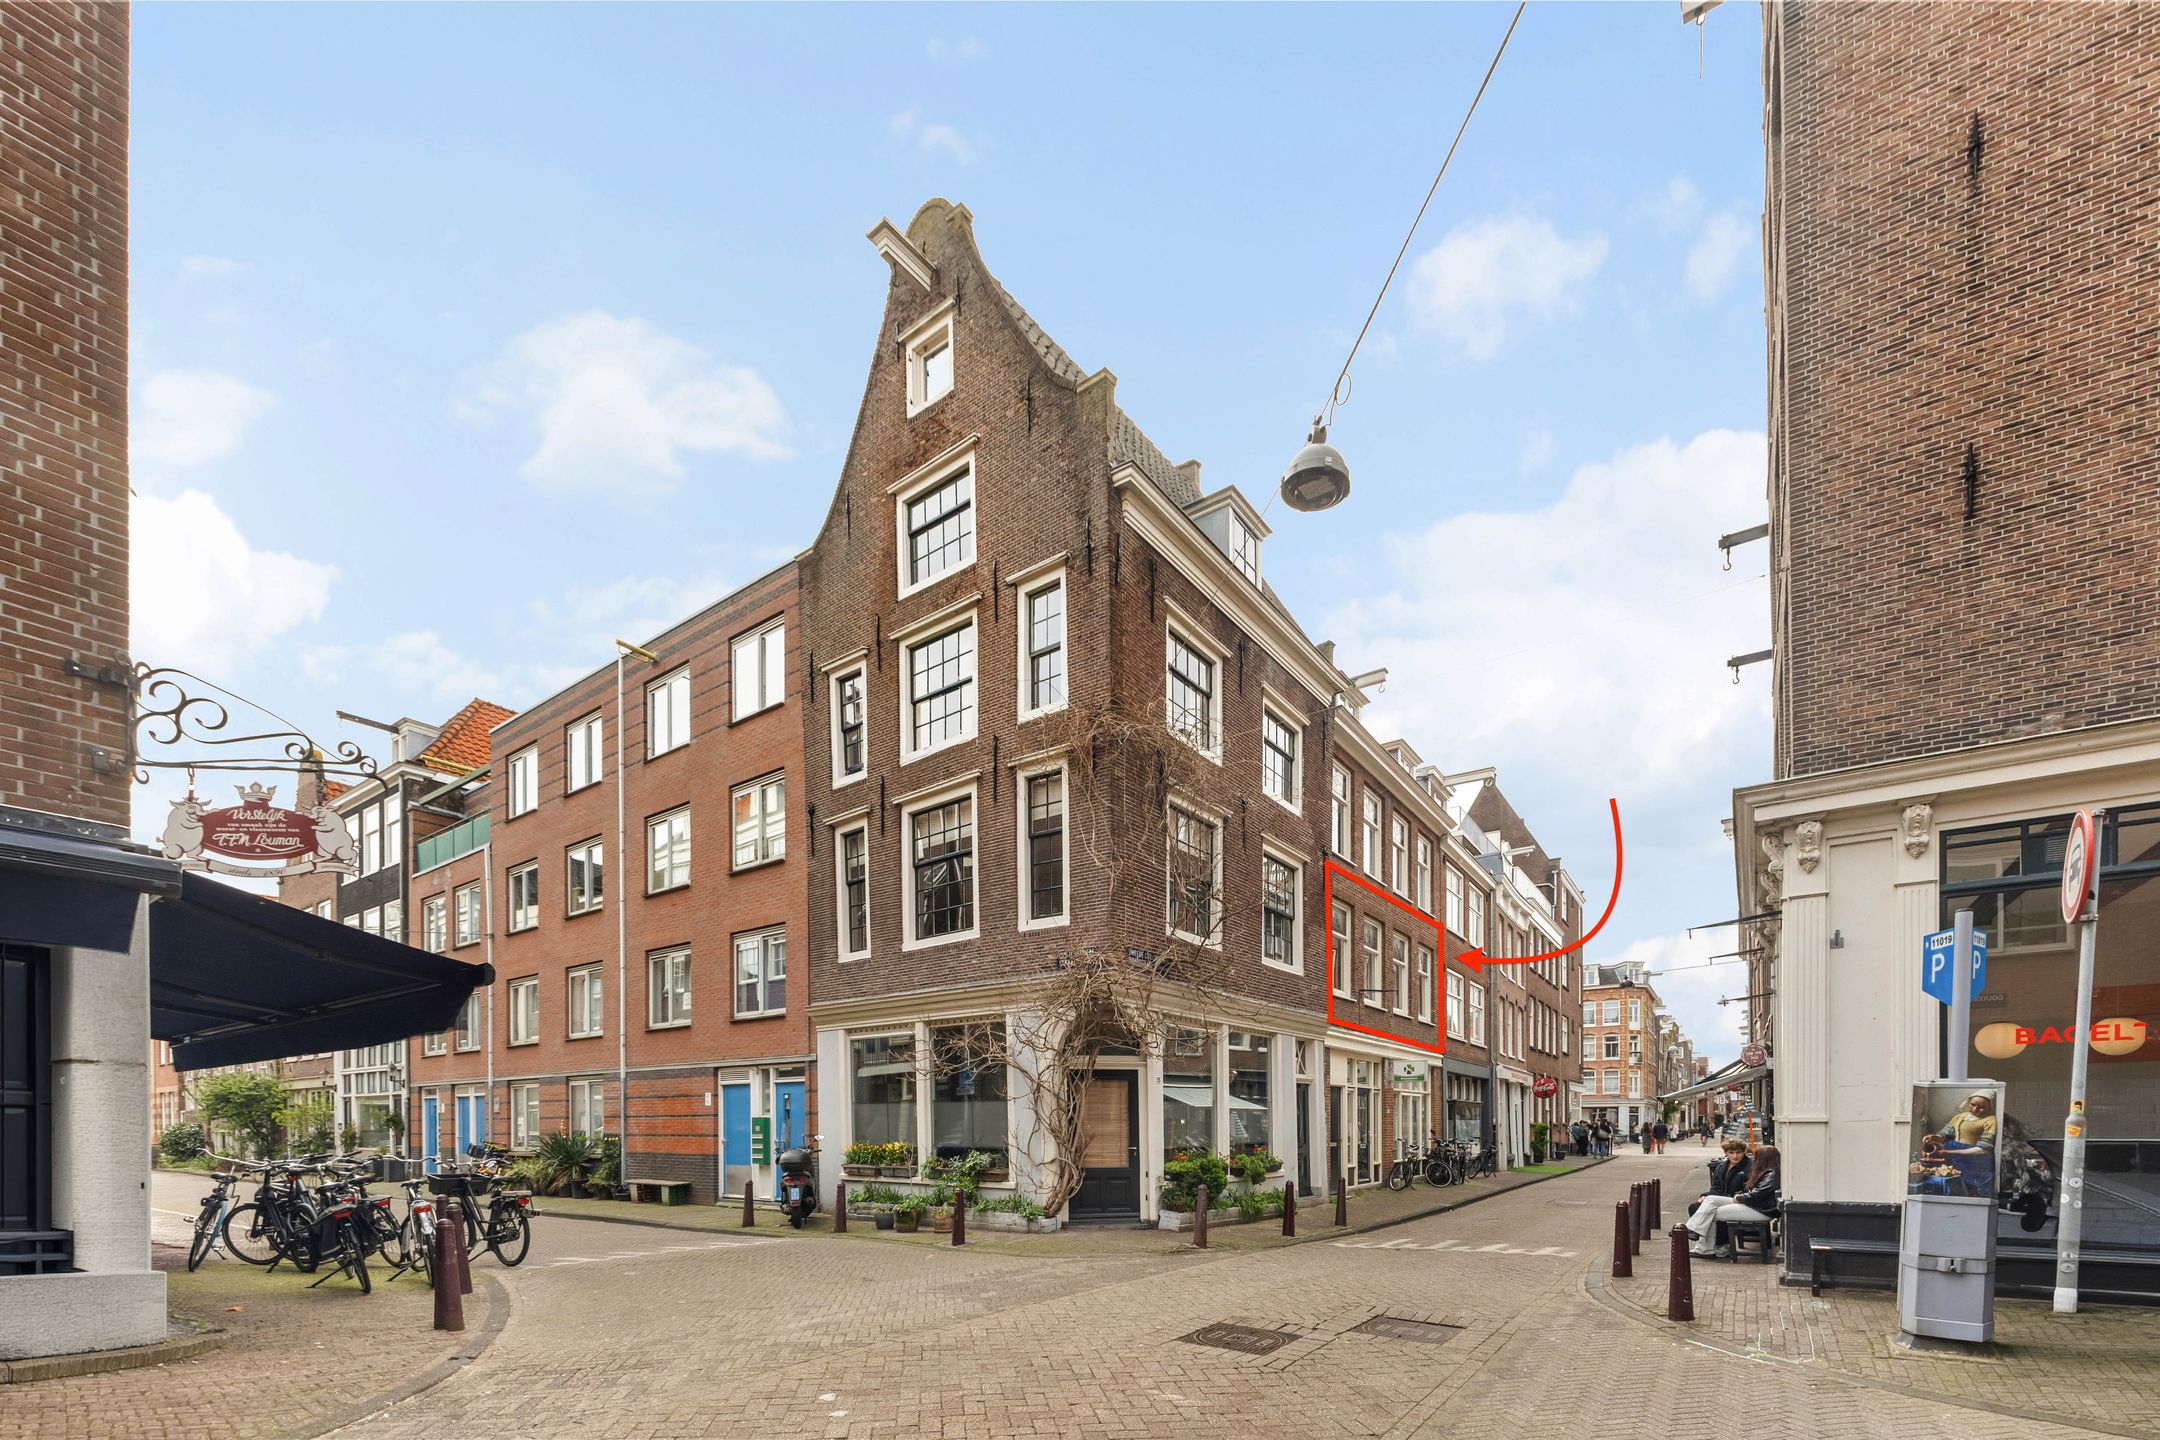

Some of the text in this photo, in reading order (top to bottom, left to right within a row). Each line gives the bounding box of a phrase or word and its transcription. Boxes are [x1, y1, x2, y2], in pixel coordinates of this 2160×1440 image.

[226, 809, 288, 822] Vorstelijk
[251, 833, 304, 851] Louman
[1931, 934, 1953, 948] 11019
[1931, 952, 1946, 983] P
[1972, 950, 1981, 980] P
